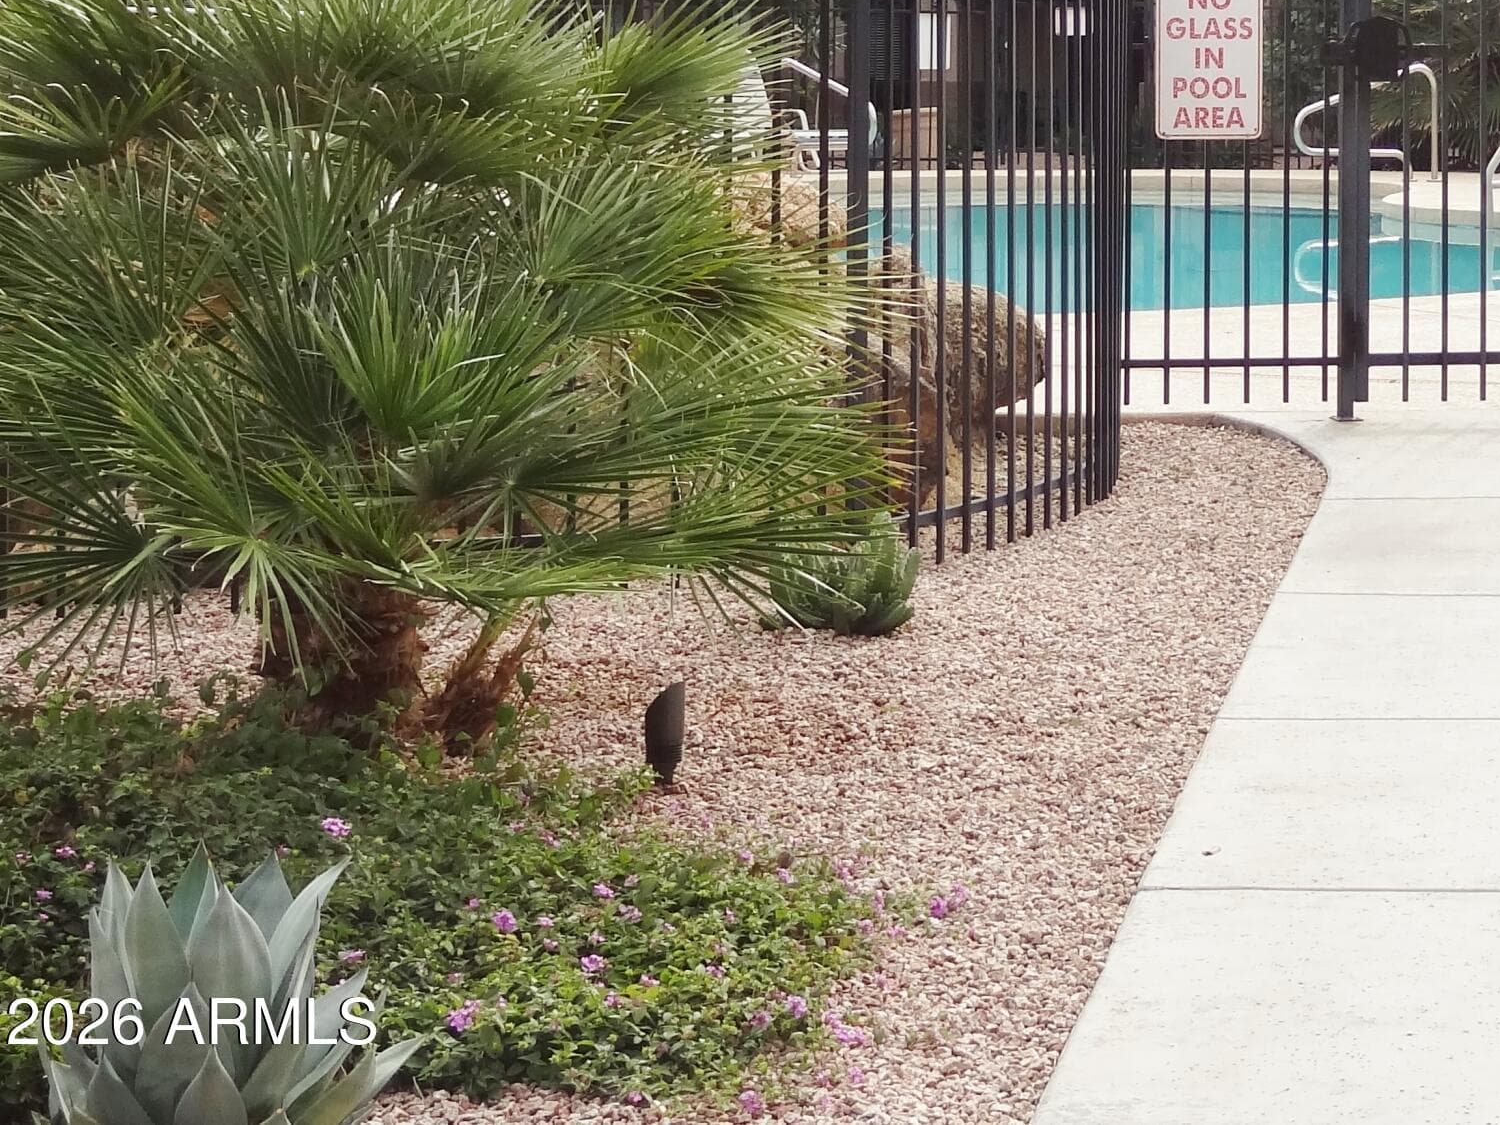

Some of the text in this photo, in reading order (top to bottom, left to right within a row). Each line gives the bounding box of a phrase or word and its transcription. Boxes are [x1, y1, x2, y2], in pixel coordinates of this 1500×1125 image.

[1166, 17, 1253, 40] GLASS
[1195, 47, 1224, 69] IN
[1172, 77, 1247, 99] POOL
[1173, 106, 1245, 129] AREA
